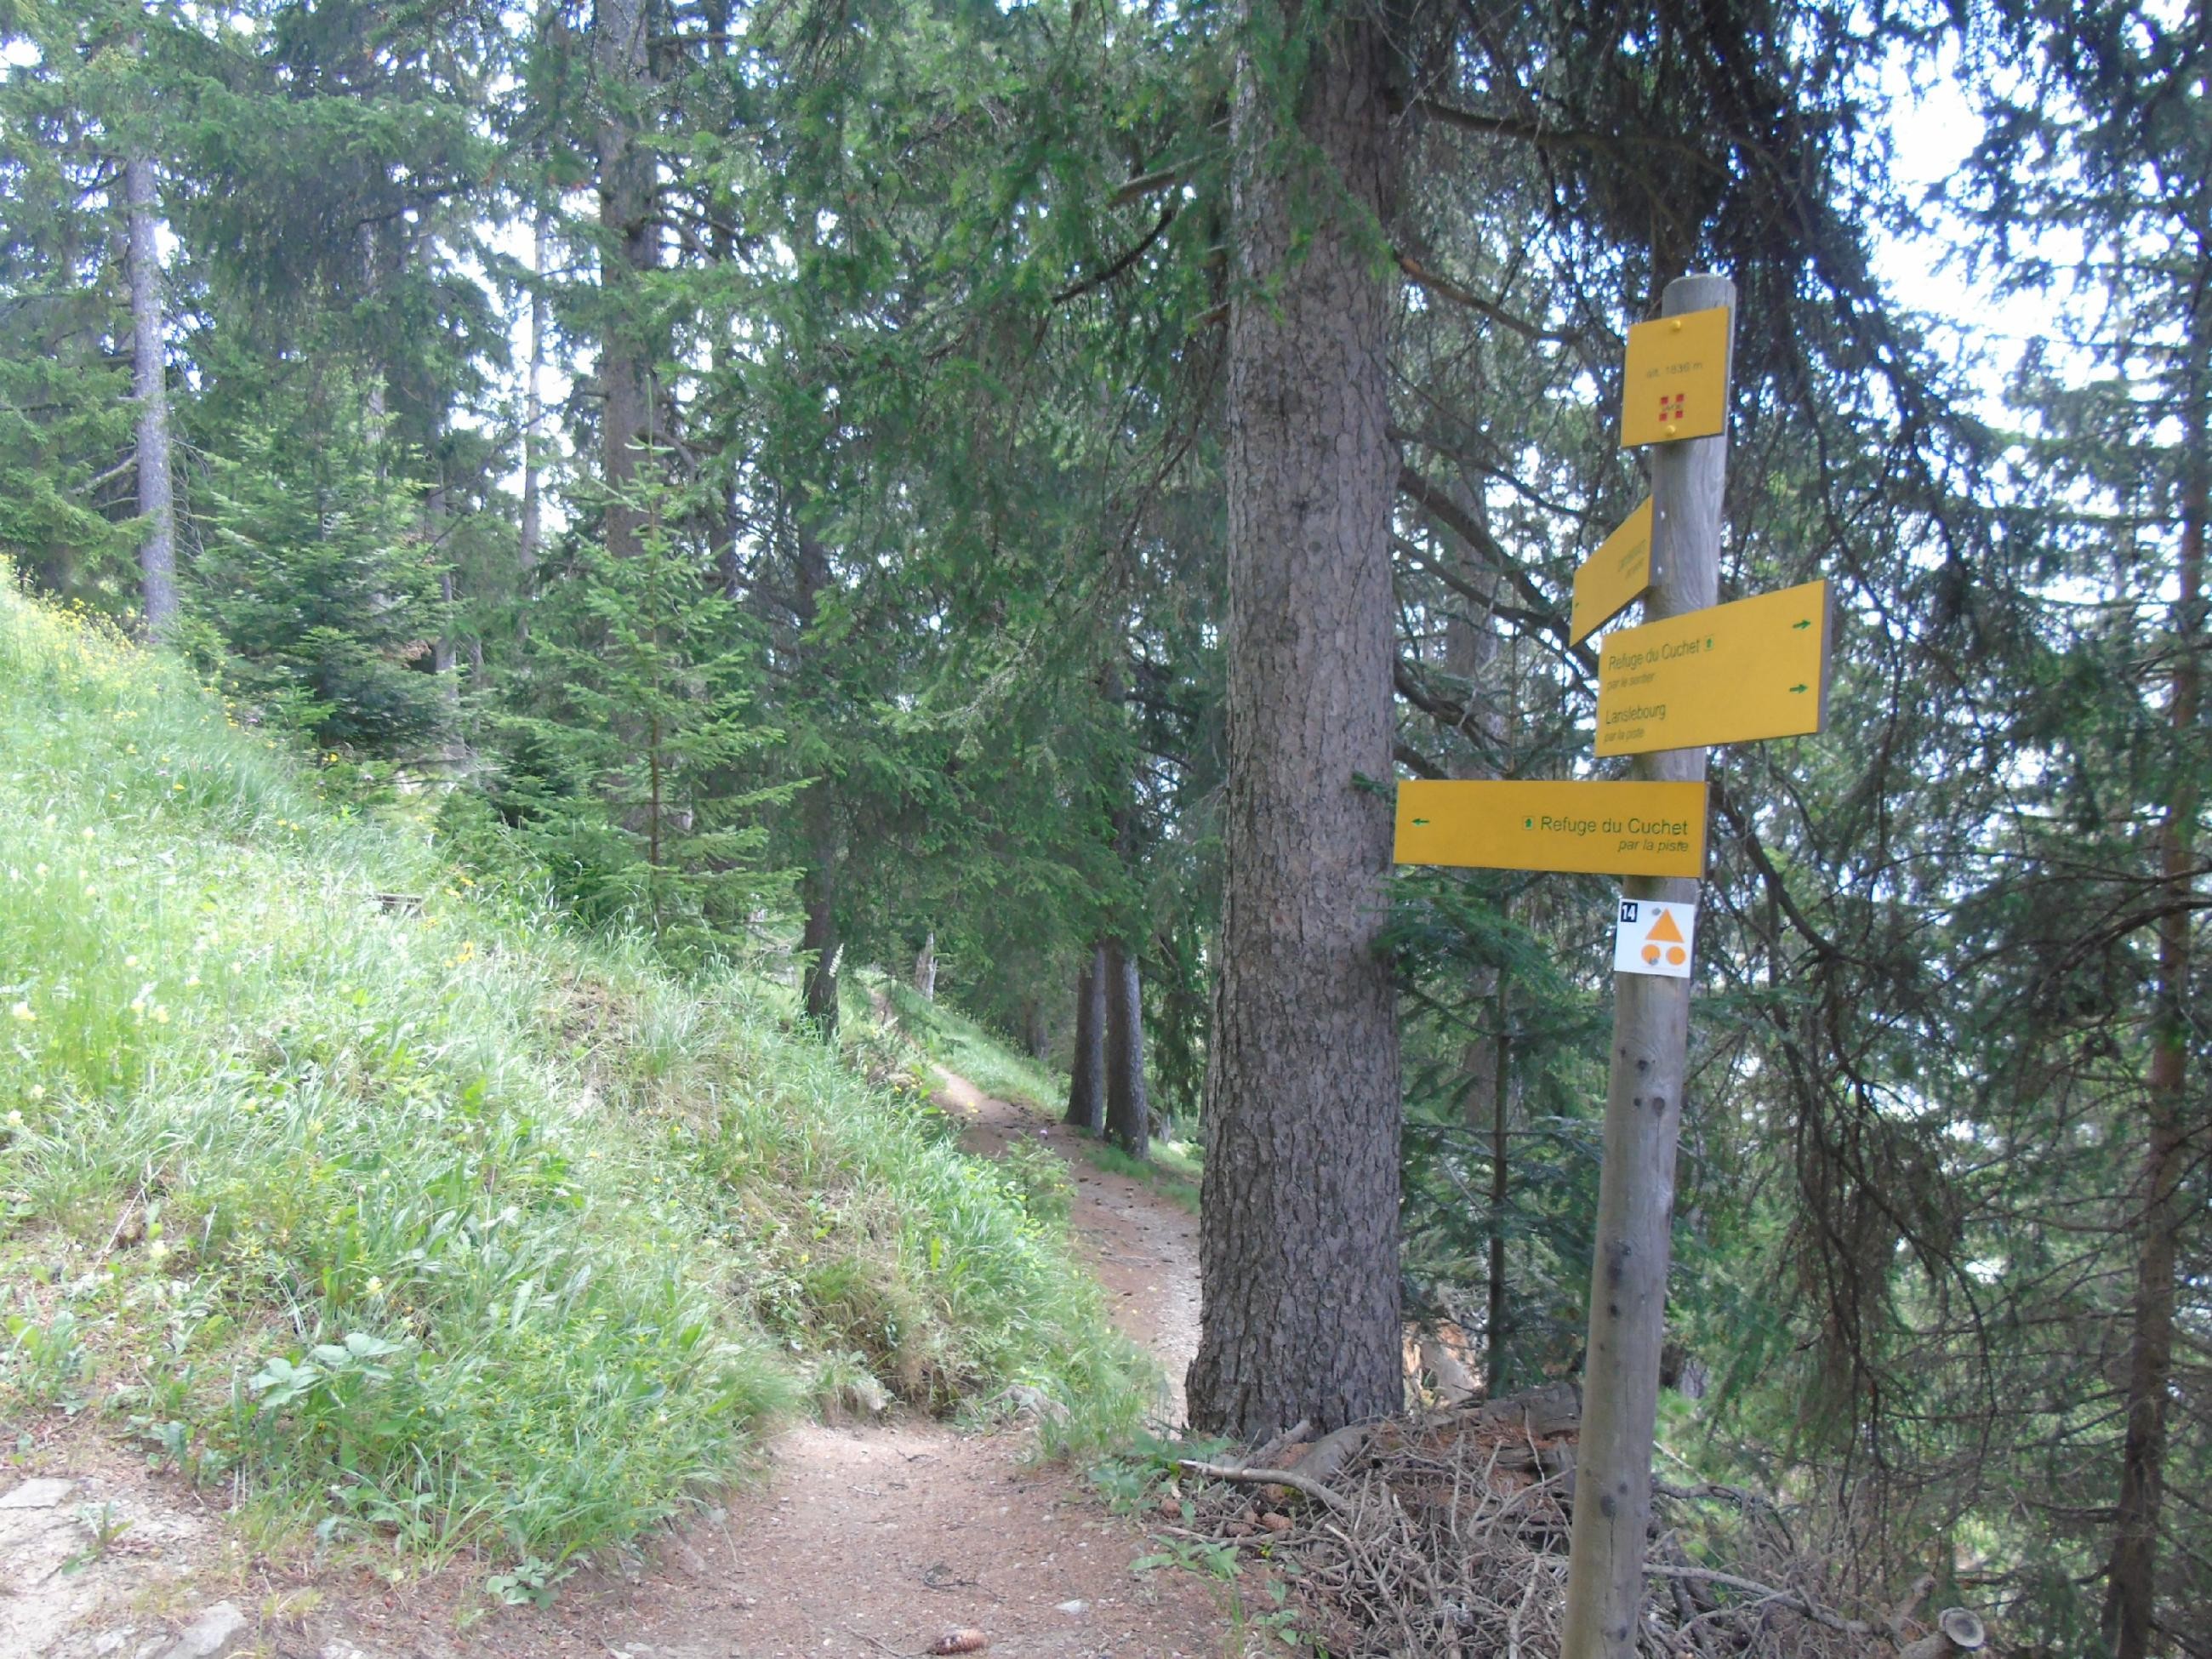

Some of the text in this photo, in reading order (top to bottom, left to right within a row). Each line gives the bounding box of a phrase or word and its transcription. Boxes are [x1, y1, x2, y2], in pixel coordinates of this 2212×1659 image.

[1608, 639, 1700, 670] Refuge du Cuchet
[1605, 704, 1666, 725] Lanslebourg
[1541, 816, 1688, 836] Refuge du Cuchet
[1618, 840, 1689, 852] par la piste
[1622, 904, 1636, 921] 14
